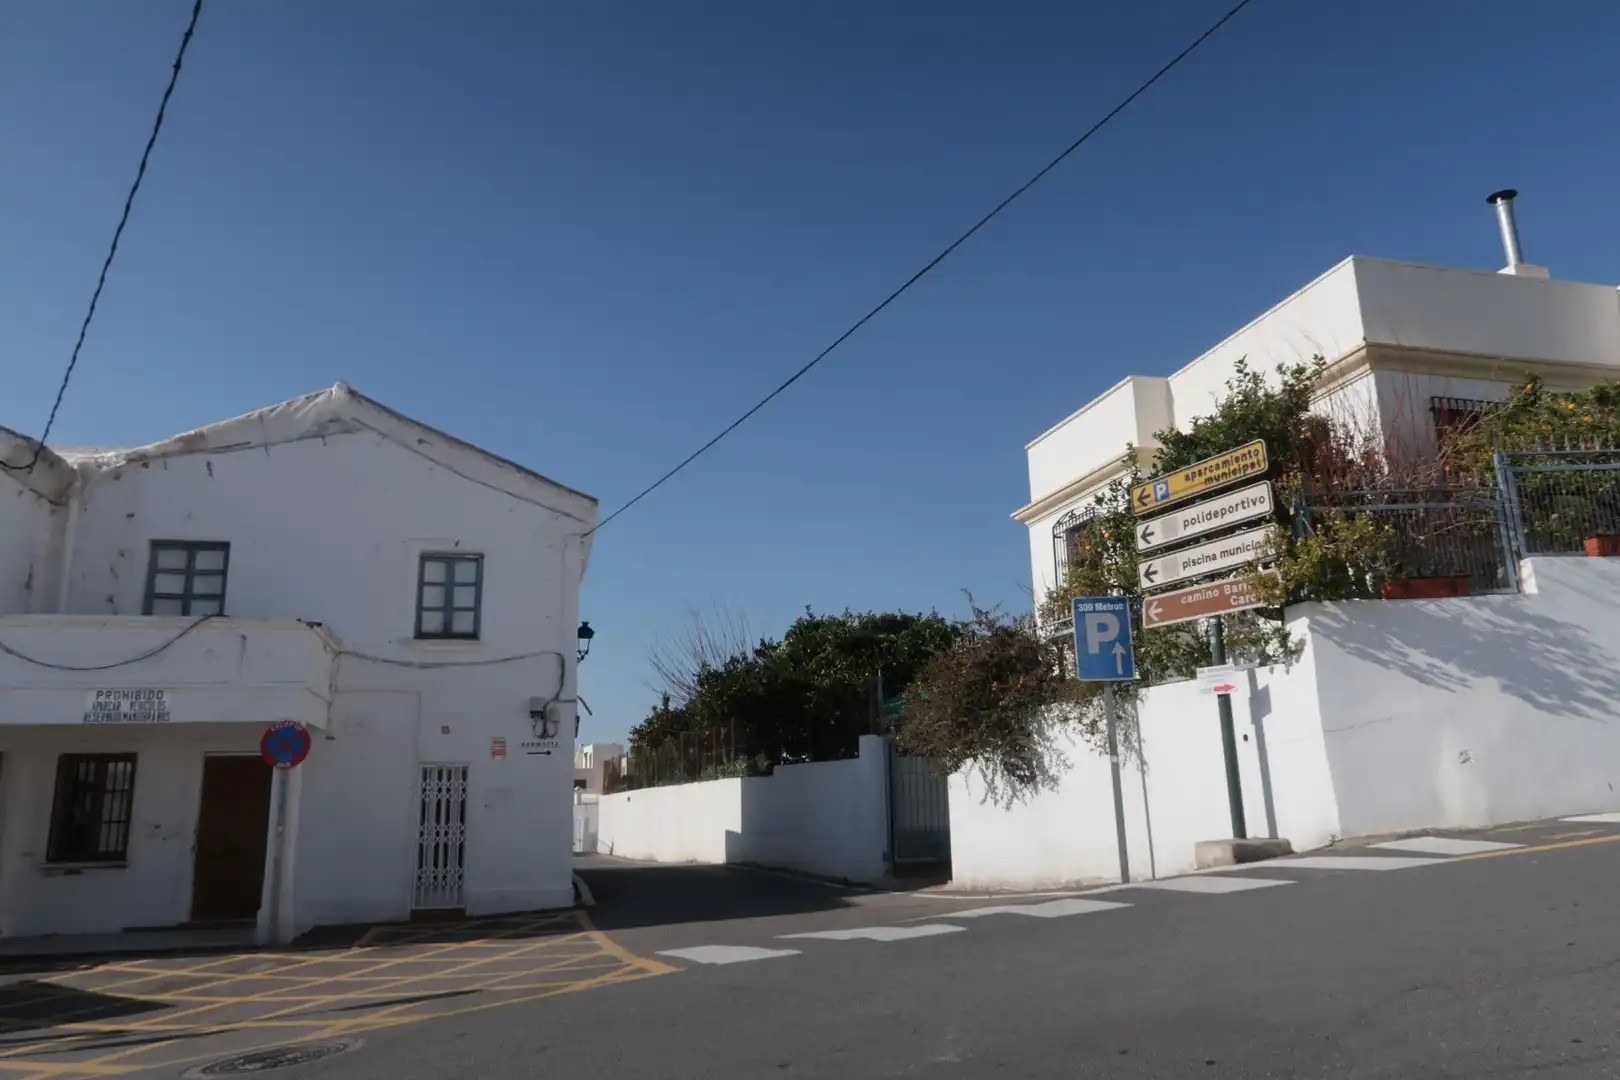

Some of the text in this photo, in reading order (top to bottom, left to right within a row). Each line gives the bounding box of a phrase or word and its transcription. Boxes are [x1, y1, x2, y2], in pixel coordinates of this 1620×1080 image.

[1155, 458, 1262, 501] P municipal
[1184, 448, 1260, 482] aparcamiento
[1183, 494, 1266, 530] polideportivo
[1182, 540, 1262, 570] piscina municip
[1078, 602, 1124, 612] 300 Metros
[1181, 588, 1220, 604] camino
[1085, 612, 1120, 655] P
[96, 690, 164, 701] PROHIBIDO
[521, 741, 560, 749] FARMACIA
